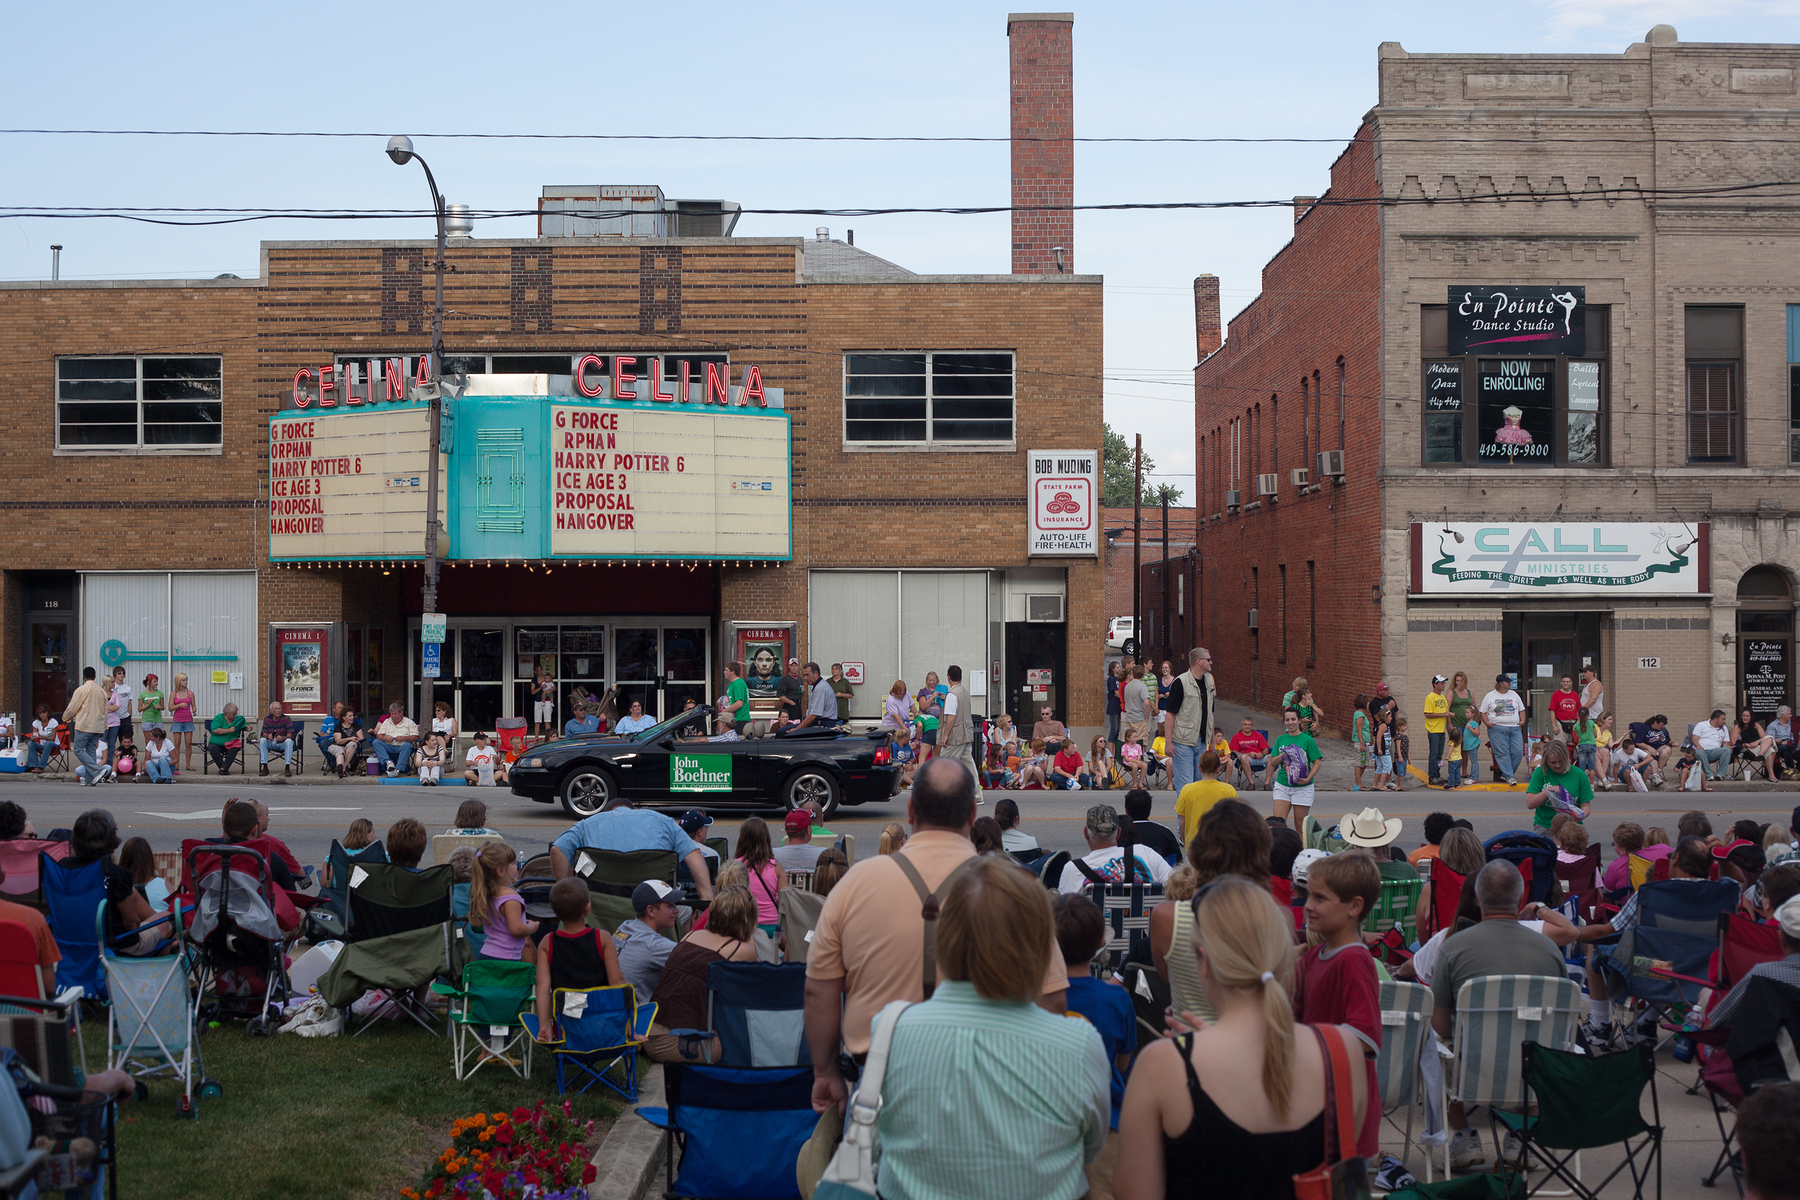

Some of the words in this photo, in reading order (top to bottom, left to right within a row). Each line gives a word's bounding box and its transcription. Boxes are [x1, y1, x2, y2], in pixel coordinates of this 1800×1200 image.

[1459, 292, 1482, 315] En
[1490, 292, 1554, 318] Pointe
[1472, 320, 1510, 330] Dance
[1514, 319, 1554, 331] Studio
[1428, 364, 1459, 374] Modern
[1500, 361, 1530, 376] NOW
[1571, 363, 1599, 373] Ballet
[293, 354, 431, 408] CELINA
[576, 354, 767, 408] CELINA
[1432, 378, 1456, 389] Jazz
[1483, 377, 1545, 390] ENROLLING!
[1571, 378, 1599, 390] Lyrical
[556, 411, 565, 427] G
[572, 412, 618, 430] FORCE
[271, 425, 278, 440] G
[282, 422, 314, 439] FORCE
[565, 432, 616, 449] RPHAN
[271, 441, 312, 459] ORPHAN
[1479, 444, 1549, 456] 419-586-9800
[272, 460, 306, 478] HARRY
[311, 458, 350, 475] POTTER
[355, 458, 361, 473] 6
[555, 452, 606, 470] HARRY
[614, 454, 670, 471] POTTER
[677, 456, 685, 472] 6
[1035, 459, 1052, 474] BOB
[1058, 459, 1091, 474] NUDING
[272, 480, 287, 496] ICE
[290, 479, 310, 496] AGE
[315, 479, 320, 495] 3
[557, 472, 581, 489] ICE
[586, 474, 614, 490] AGE
[619, 474, 626, 490] 3
[271, 498, 324, 516] PROPOSAL
[556, 492, 634, 510] PROPOSAL
[271, 517, 324, 534] HANGOVER
[557, 513, 634, 530] HANGOVER
[1474, 528, 1628, 552] CALL
[1528, 564, 1608, 574] MINISTRIES
[1452, 571, 1482, 580] FEEDING
[1487, 572, 1503, 580] THE
[1508, 575, 1536, 585] SPIRIT
[1630, 572, 1650, 584] BODY
[174, 645, 196, 655] Cancer
[198, 646, 236, 655] Association
[1749, 642, 1758, 650] En
[1760, 642, 1782, 650] Pointe
[1641, 658, 1657, 667] 112
[674, 756, 698, 770] John
[674, 768, 730, 782] Boehner
